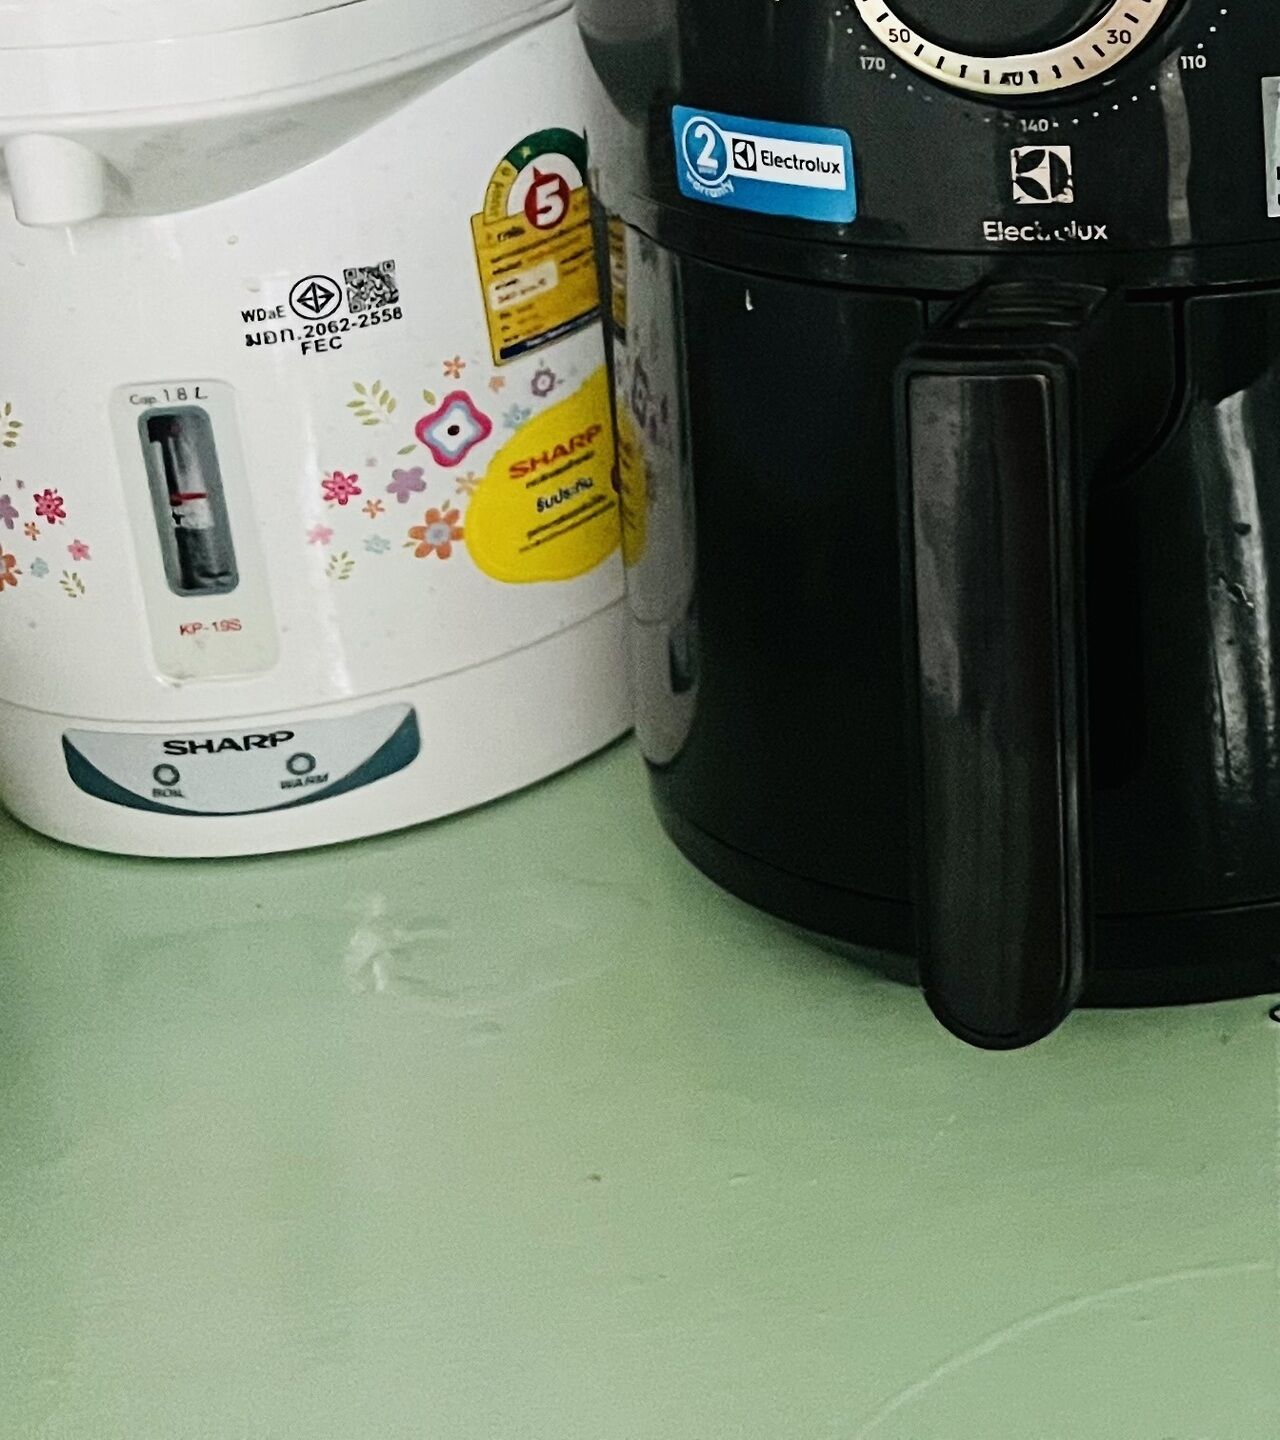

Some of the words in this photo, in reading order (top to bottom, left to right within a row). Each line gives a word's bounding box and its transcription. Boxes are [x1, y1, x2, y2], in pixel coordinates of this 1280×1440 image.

[889, 28, 911, 43] 50
[1107, 29, 1132, 44] 30
[860, 57, 886, 71] 170
[1181, 55, 1207, 69] 110
[1020, 119, 1049, 133] 140
[694, 124, 719, 168] 2
[760, 150, 841, 174] Electrolux
[535, 177, 566, 227] 5
[245, 306, 403, 347] มอก.2062-2558
[301, 336, 343, 355] FEC
[195, 386, 208, 400] L
[509, 423, 602, 479] SHARP
[163, 730, 295, 755] SHARP
